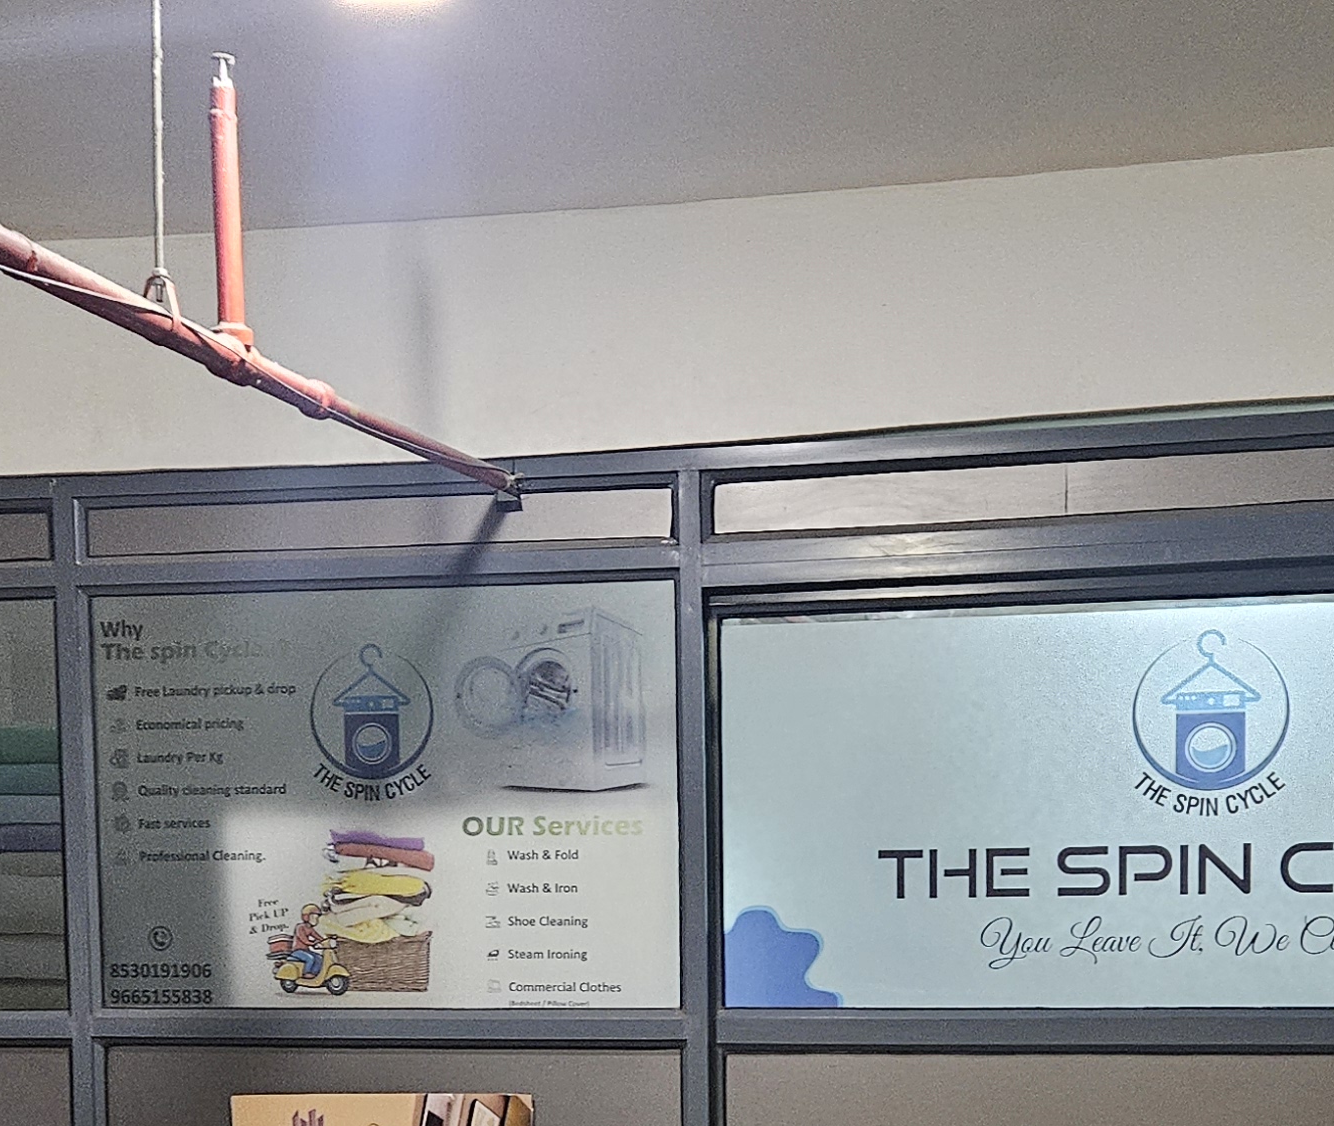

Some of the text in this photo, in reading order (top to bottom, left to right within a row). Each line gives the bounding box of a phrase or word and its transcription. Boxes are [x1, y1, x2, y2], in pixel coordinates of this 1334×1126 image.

[100, 620, 143, 641] Why
[101, 642, 144, 660] The
[151, 642, 196, 664] spin
[135, 683, 296, 698] Free Laundry pickup & drop
[136, 720, 244, 732] Economical pricing
[137, 751, 223, 764] Laundry Per Kg
[313, 763, 432, 801] THE SPIN CYCLE
[138, 783, 287, 797] Quality cleaning standard
[1134, 772, 1286, 817] THE SPIN CYCLE
[138, 818, 211, 829] Fast services
[462, 815, 644, 836] OUR Services
[140, 850, 267, 863] Professional Cleaning.
[507, 849, 579, 861] Wash & Fold
[877, 847, 1031, 900] THE
[1056, 841, 1252, 897] SPIN
[507, 883, 578, 894] Wash & Iron
[258, 899, 279, 907] Free
[249, 908, 289, 921] Pick UP
[508, 916, 588, 928] Shoe Cleaning
[249, 926, 258, 934] &
[980, 917, 1053, 971] You
[1064, 915, 1143, 966] Leave
[1215, 917, 1290, 956] We
[508, 949, 588, 961] Steam Ironing
[110, 963, 212, 978] 8530191906
[508, 981, 622, 993] Commercial Clothes
[111, 990, 212, 1004] 9665155838
